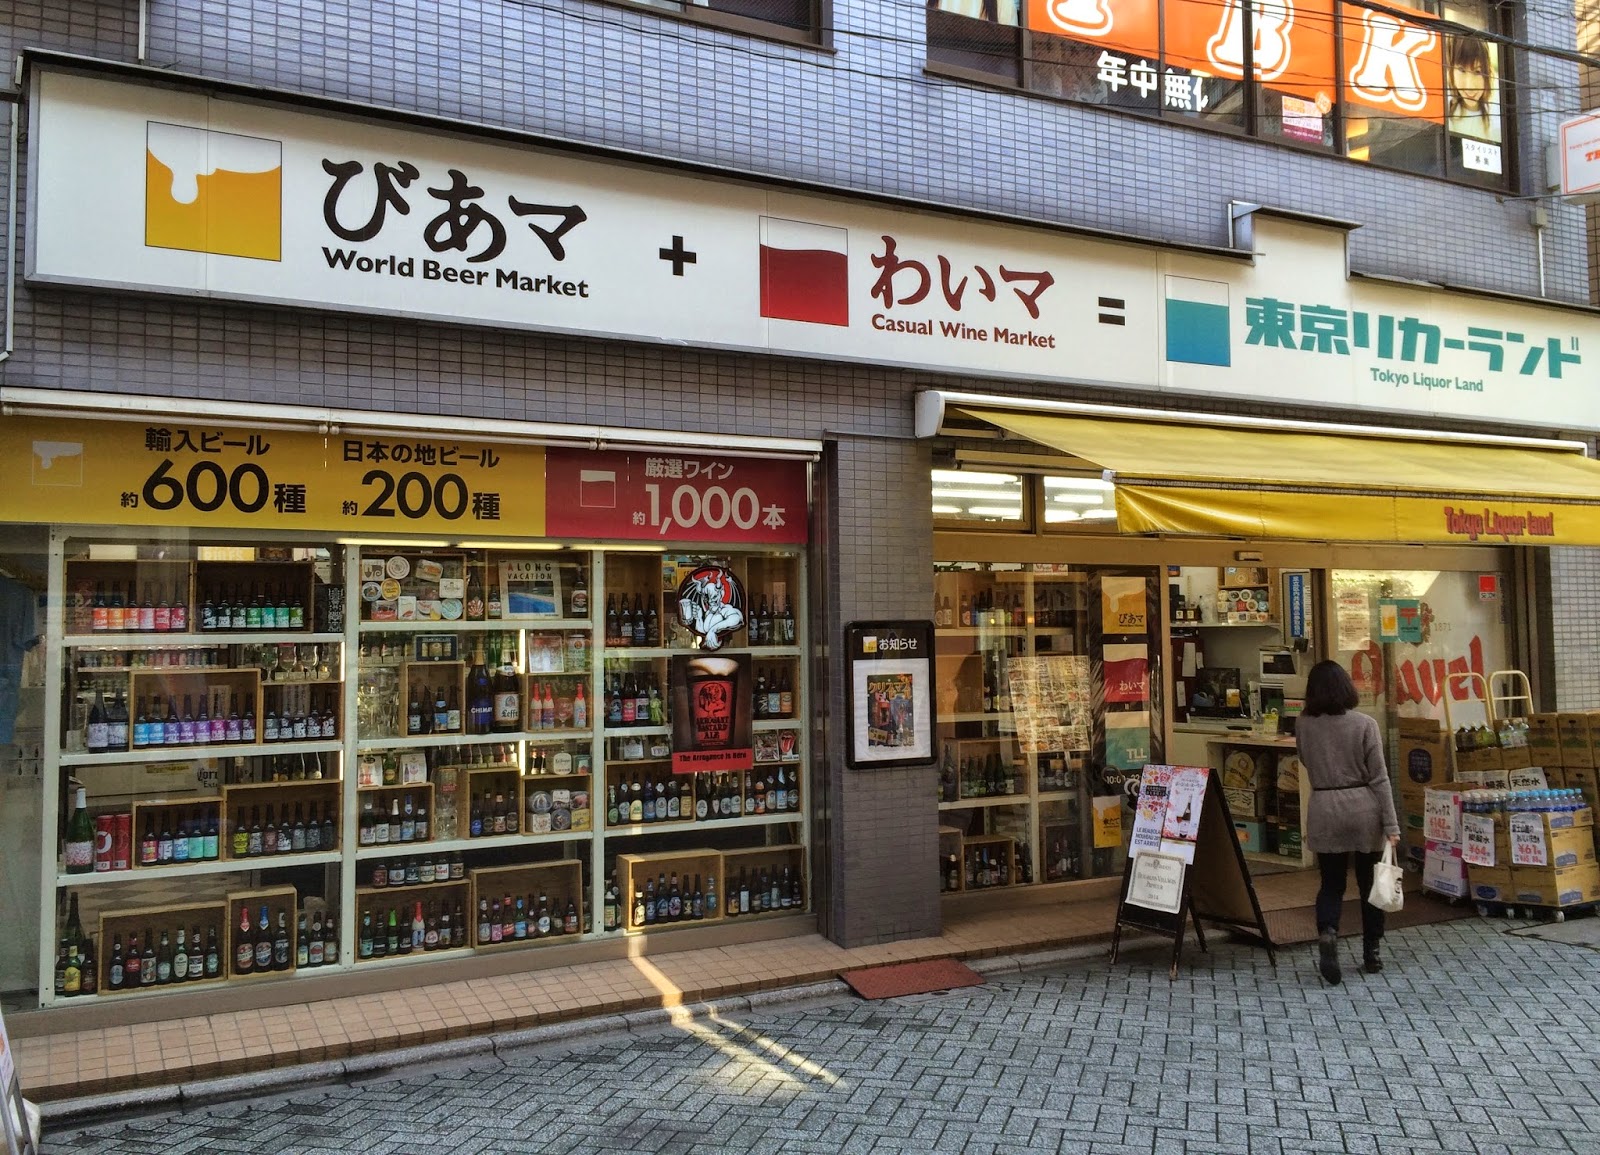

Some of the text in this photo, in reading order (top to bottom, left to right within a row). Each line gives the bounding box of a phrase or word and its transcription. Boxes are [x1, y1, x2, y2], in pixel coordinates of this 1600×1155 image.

[1465, 143, 1498, 156] スタイリスト
[322, 158, 587, 262] びあマ
[322, 247, 589, 299] World Beer Market
[870, 235, 1055, 320] わいマ
[871, 313, 1056, 349] Casual Wine Market
[1245, 297, 1582, 379] 東京リカーランド
[1370, 368, 1483, 392] Tokyo Liquor Land
[145, 428, 270, 456] 輸入ビール
[343, 440, 500, 469] 日本の地ビール
[645, 457, 734, 480] 厳選ワイン
[1444, 506, 1483, 541] Tokyo
[1484, 508, 1526, 542] Liquor
[1119, 613, 1144, 624] びあマ
[879, 638, 918, 651] お知らせ
[868, 681, 912, 694] クリスマス
[1119, 681, 1145, 691] わいマ
[693, 753, 724, 762] Arrogance
[733, 752, 747, 760] Here
[1126, 748, 1147, 760] TLL
[1511, 777, 1541, 787] 天然水
